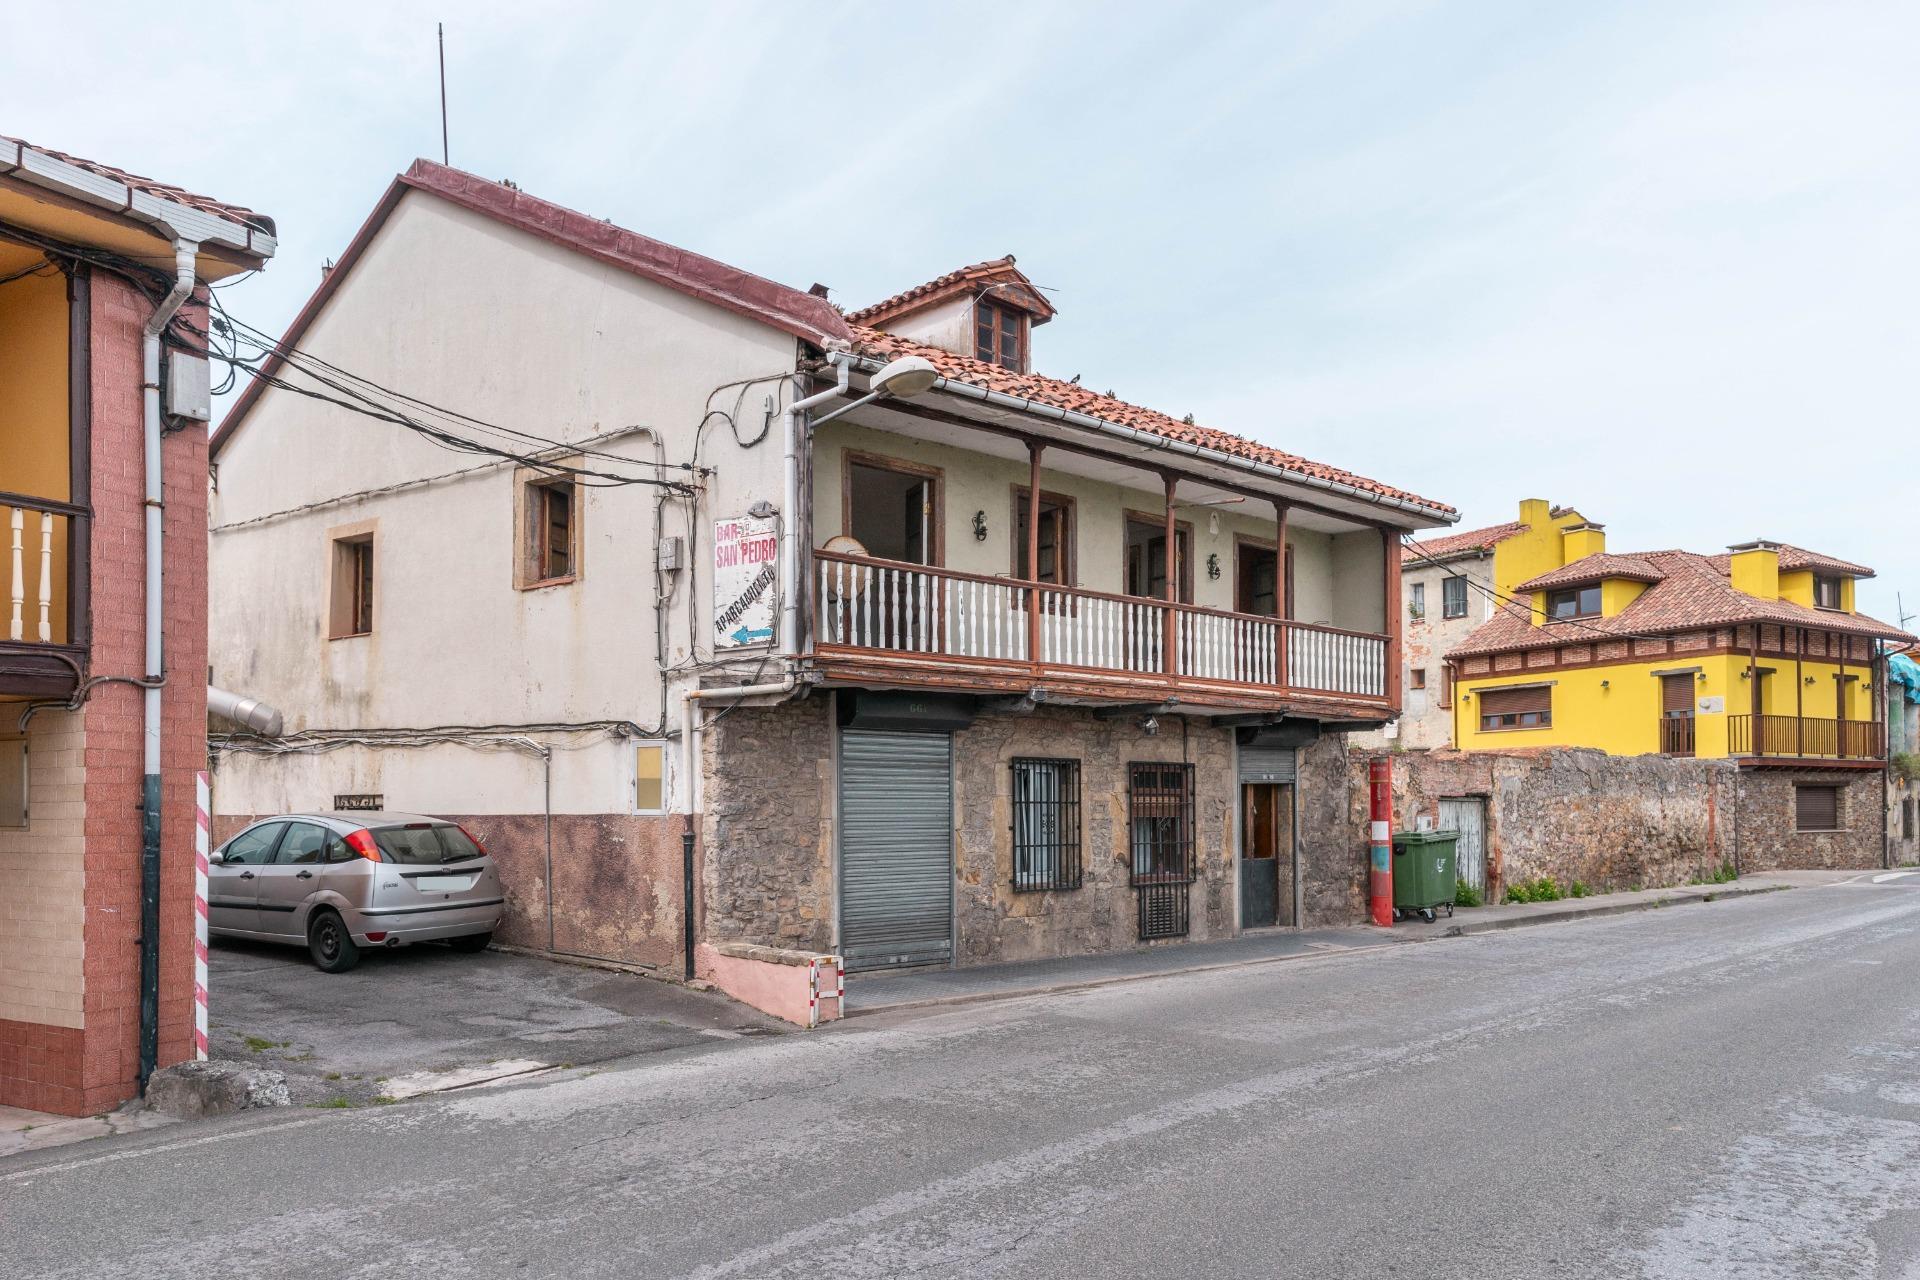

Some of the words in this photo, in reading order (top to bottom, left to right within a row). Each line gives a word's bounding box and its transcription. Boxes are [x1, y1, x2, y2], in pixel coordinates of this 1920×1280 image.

[717, 523, 738, 542] BAR
[716, 544, 738, 569] SAN
[741, 537, 776, 565] PEDRO
